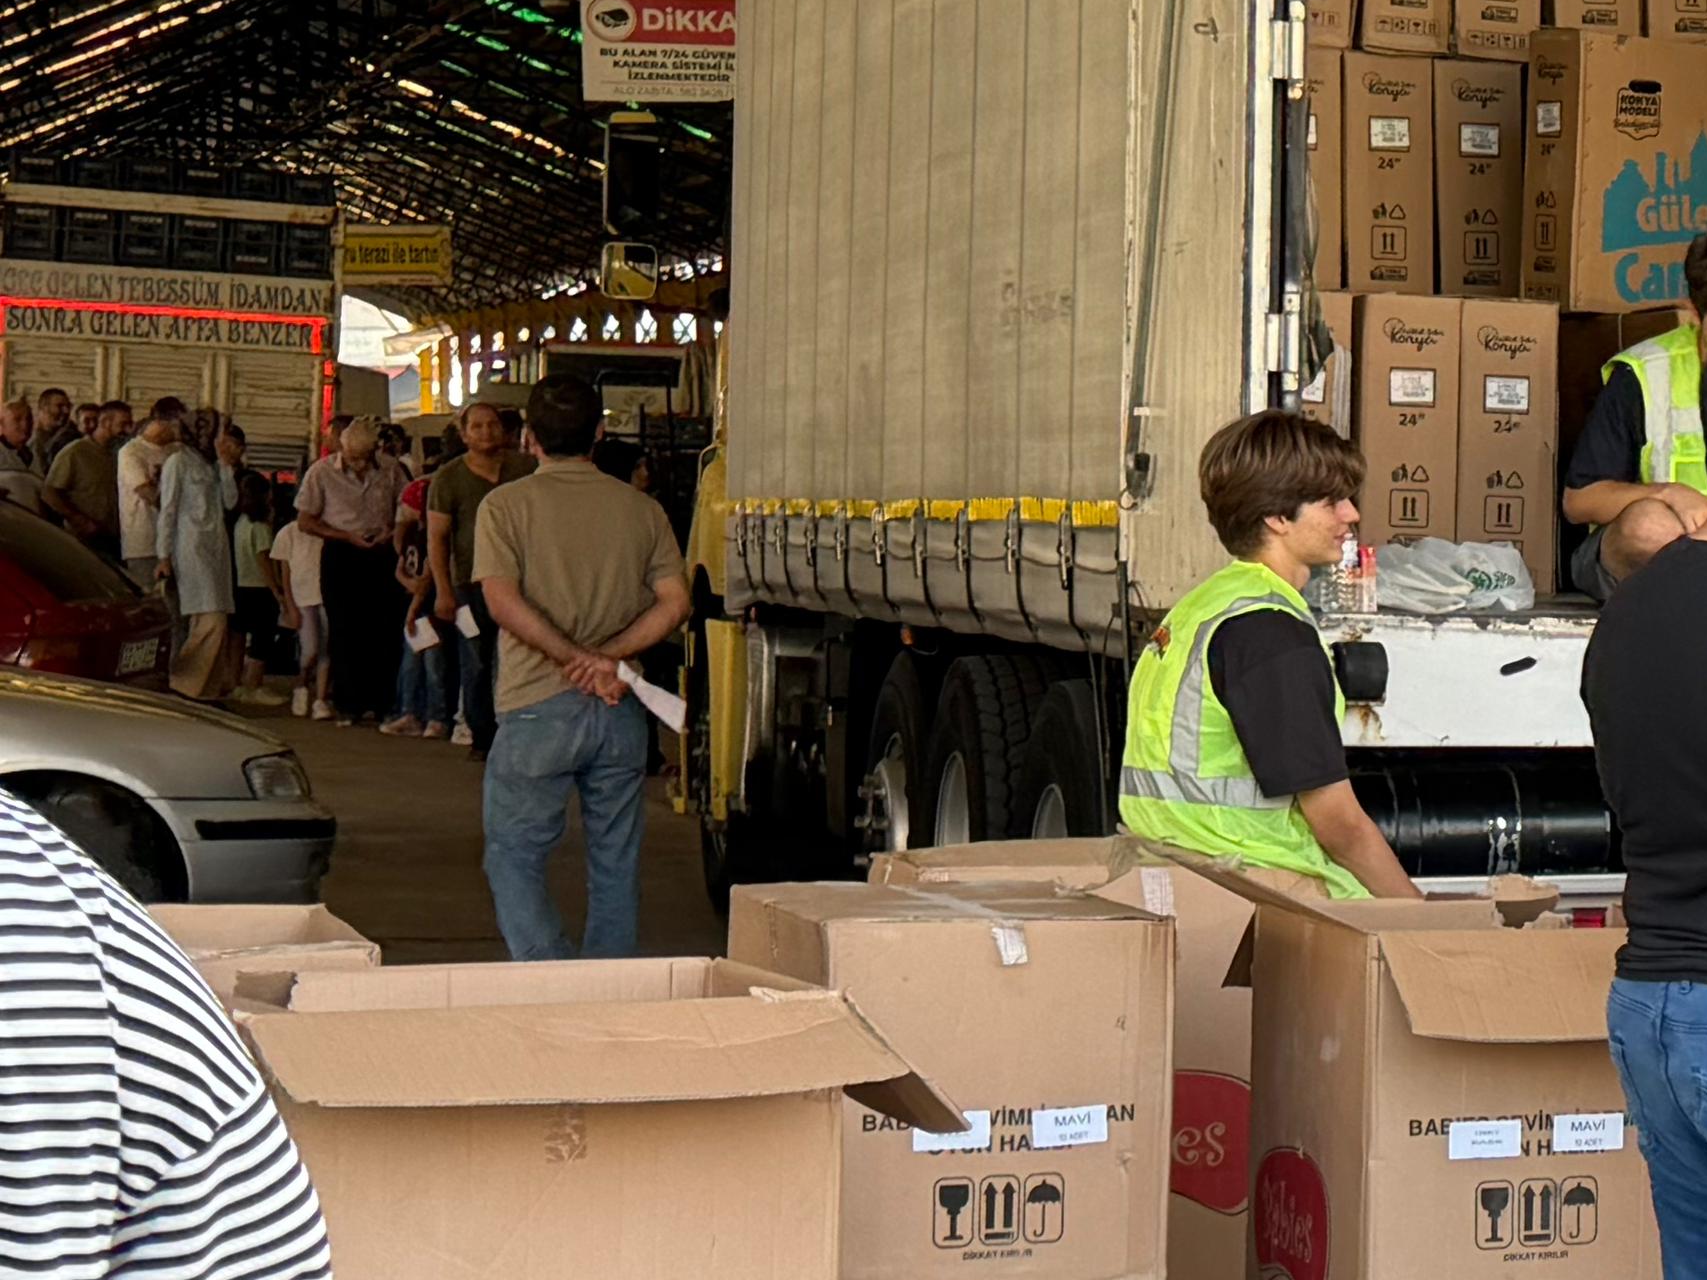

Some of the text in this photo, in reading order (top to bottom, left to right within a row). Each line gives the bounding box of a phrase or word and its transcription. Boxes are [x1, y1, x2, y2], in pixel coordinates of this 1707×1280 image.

[642, 6, 736, 32] DİKKA
[692, 47, 736, 60] GÜVEN
[613, 60, 668, 70] KAMERA
[862, 1113, 912, 1132] BAB
[1054, 1111, 1091, 1127] MAVİ
[1570, 1118, 1606, 1132] MAVİ
